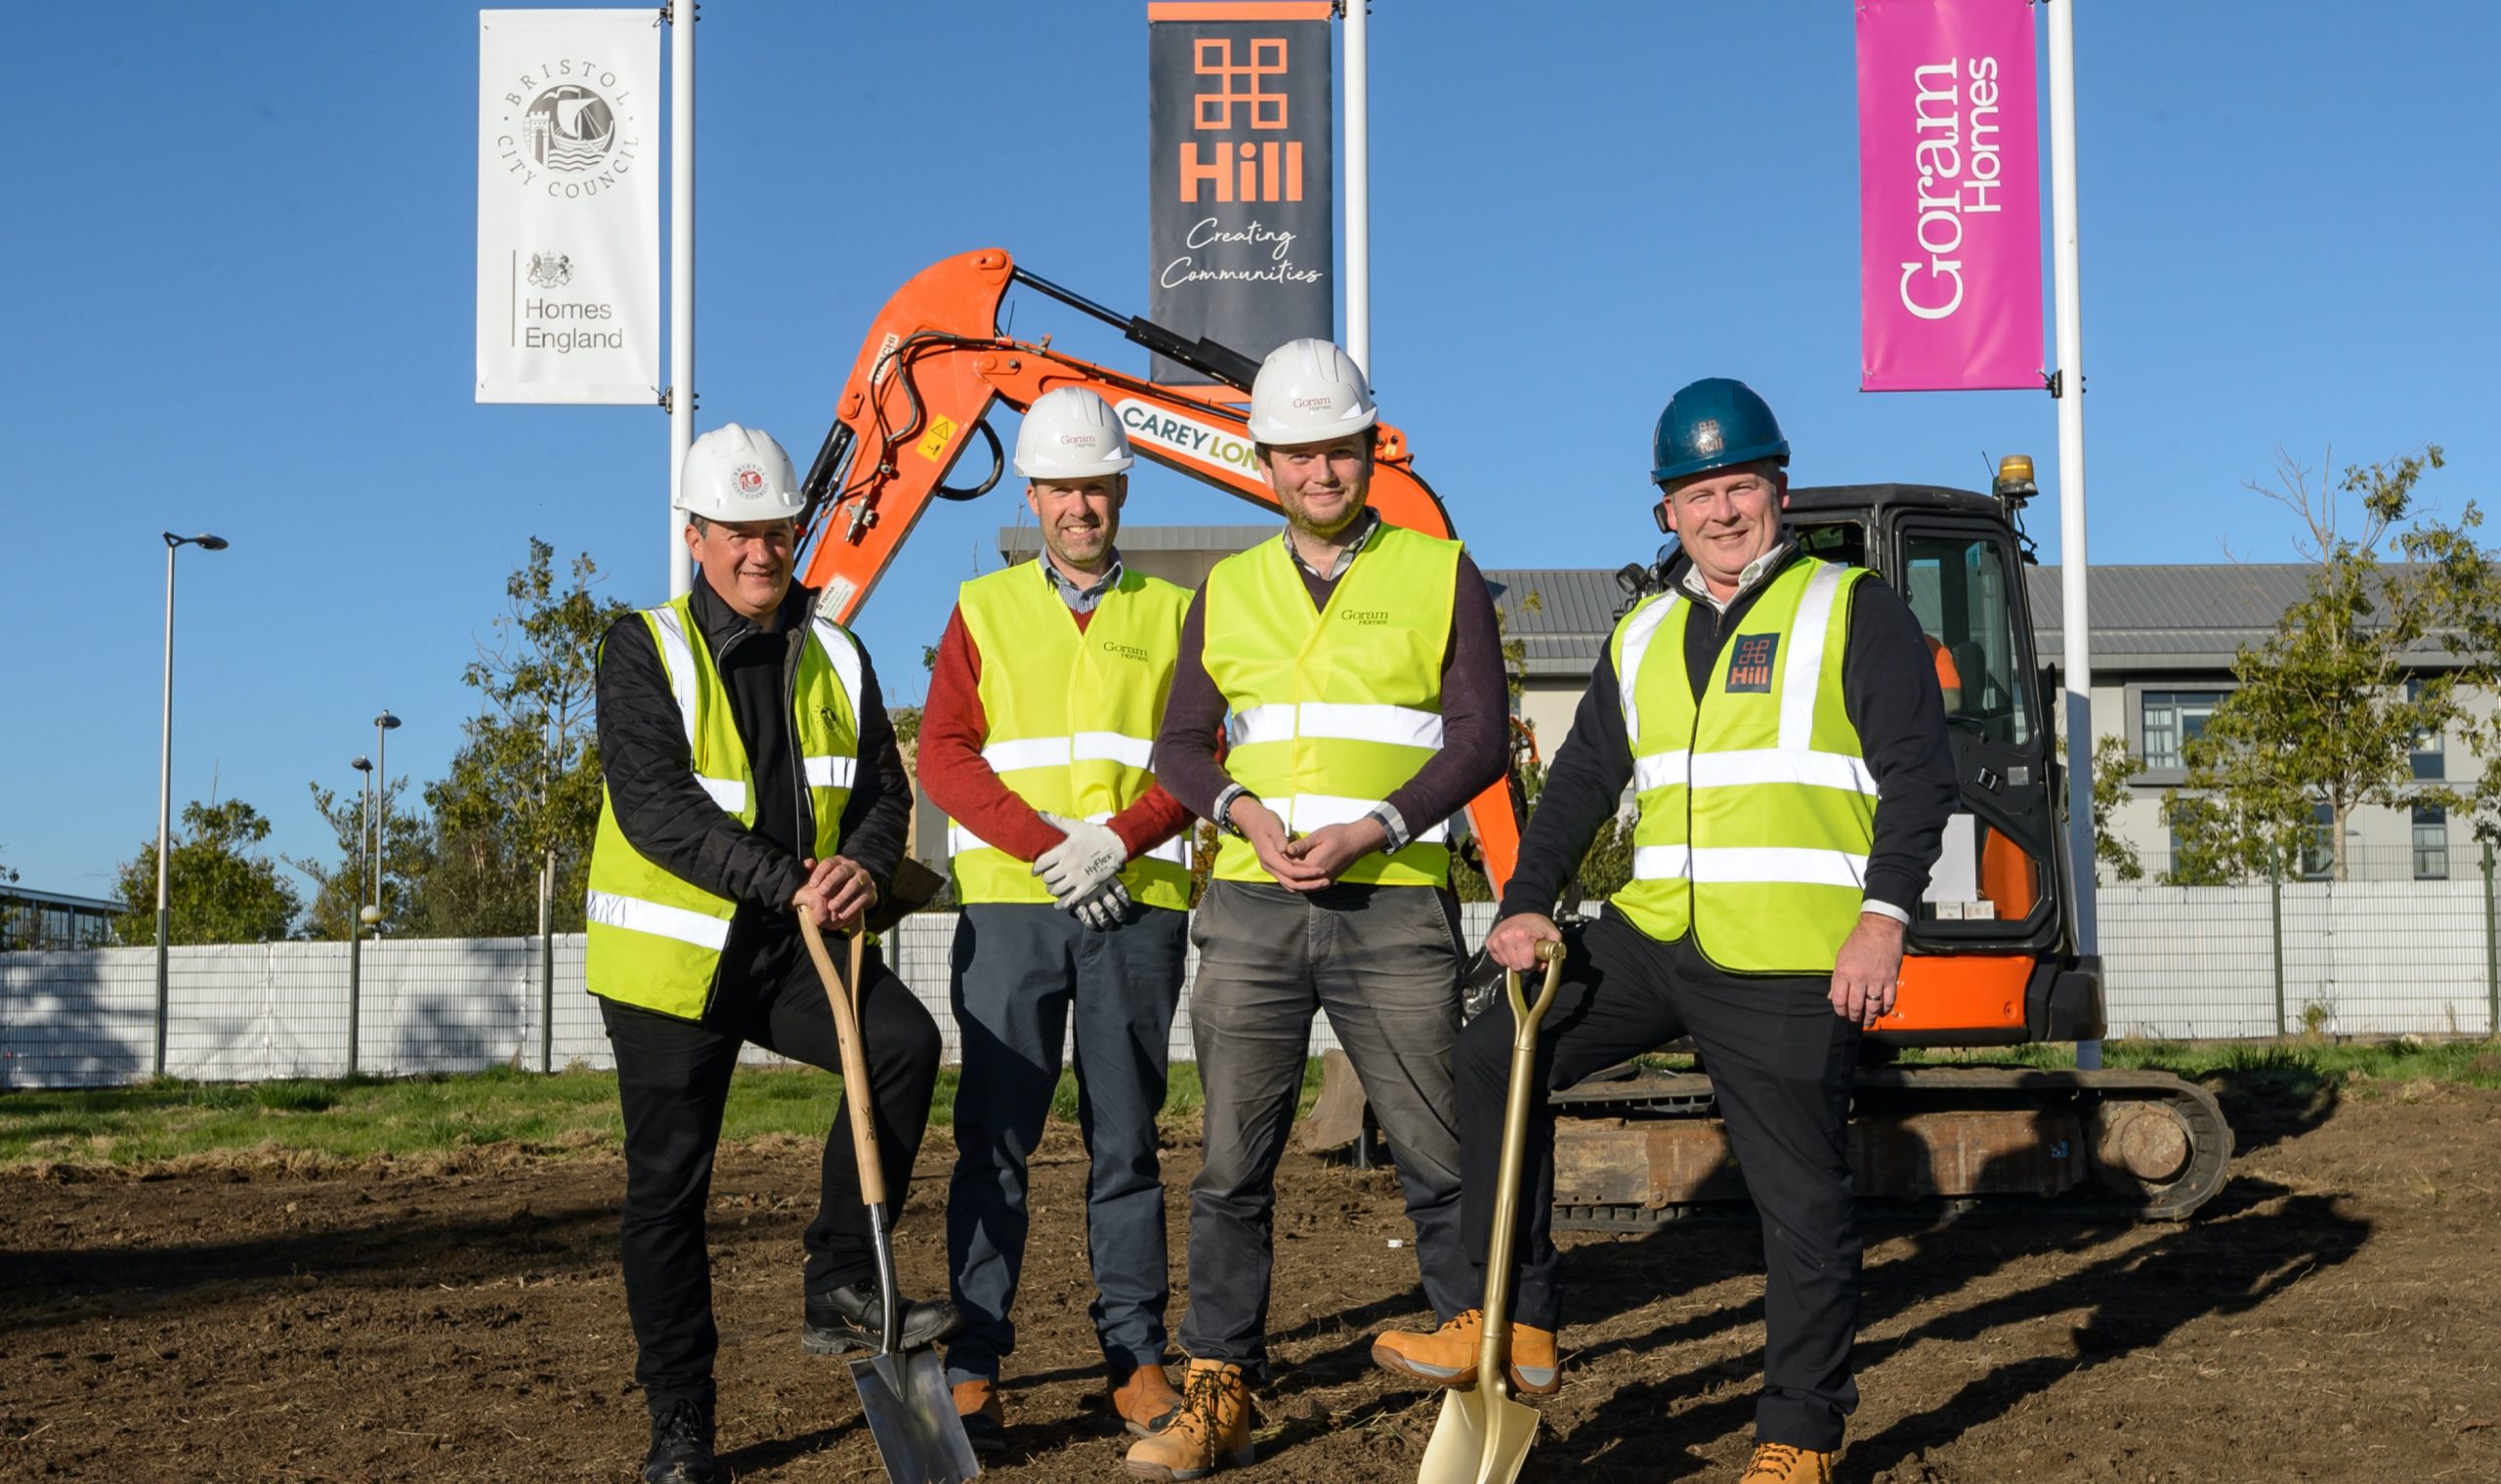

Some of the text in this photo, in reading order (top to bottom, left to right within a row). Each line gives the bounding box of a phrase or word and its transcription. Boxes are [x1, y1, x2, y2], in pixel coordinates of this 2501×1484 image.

[504, 59, 629, 107] BRISTOL
[1963, 56, 2002, 213] Homes
[497, 135, 640, 198] CITY COUNCIL
[1179, 142, 1302, 202] Hill
[1899, 57, 1964, 320] Goram
[1185, 217, 1296, 260] Creating
[1160, 257, 1323, 289] Communities
[525, 297, 612, 319] Homes
[525, 326, 623, 355] England
[1293, 397, 1331, 408] Goram
[1123, 406, 1210, 450] CAREY
[1341, 609, 1389, 620] Goram
[1103, 641, 1147, 657] Goram
[1730, 666, 1768, 685] Hill
[1084, 854, 1112, 876] HyFlex
